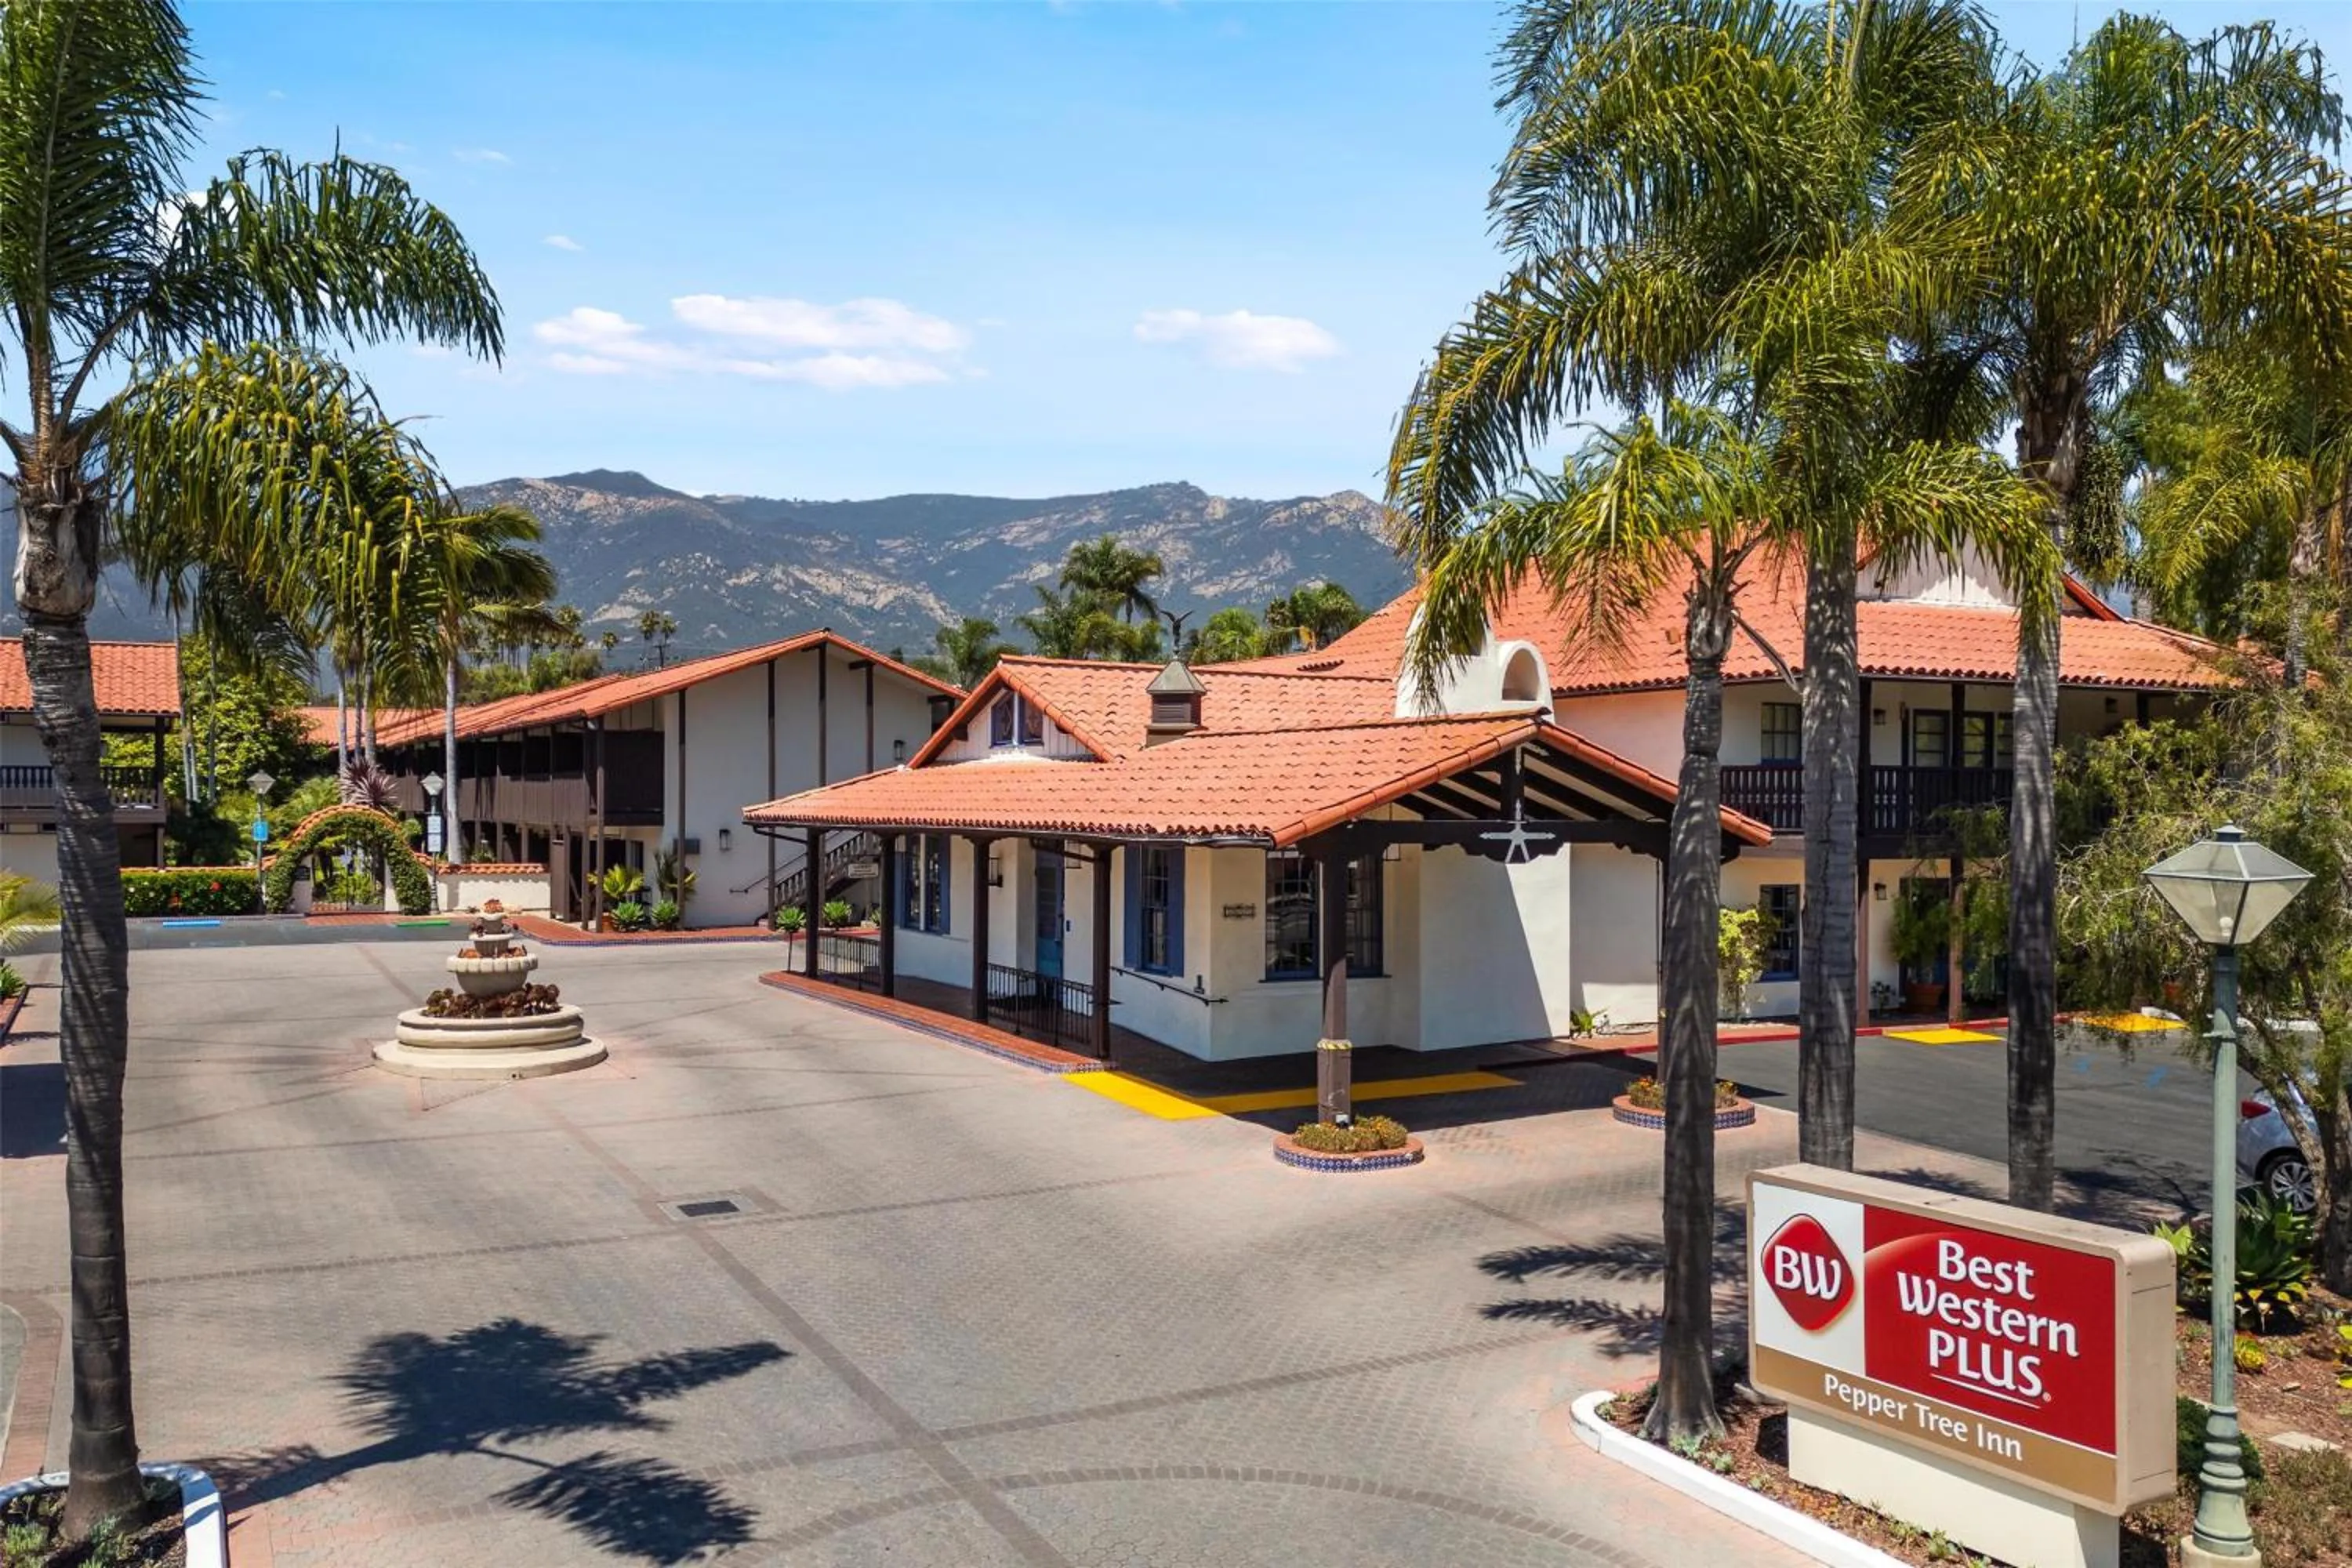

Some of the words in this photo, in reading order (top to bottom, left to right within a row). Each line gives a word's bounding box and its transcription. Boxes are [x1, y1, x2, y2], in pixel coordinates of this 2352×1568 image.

[1774, 1244, 1842, 1301] BW
[1938, 1239, 2036, 1301] Best
[1896, 1271, 2080, 1357] Western
[1824, 1373, 1907, 1421] Pepper
[1913, 1402, 1969, 1443] Tree
[1976, 1422, 2024, 1461] Inn
